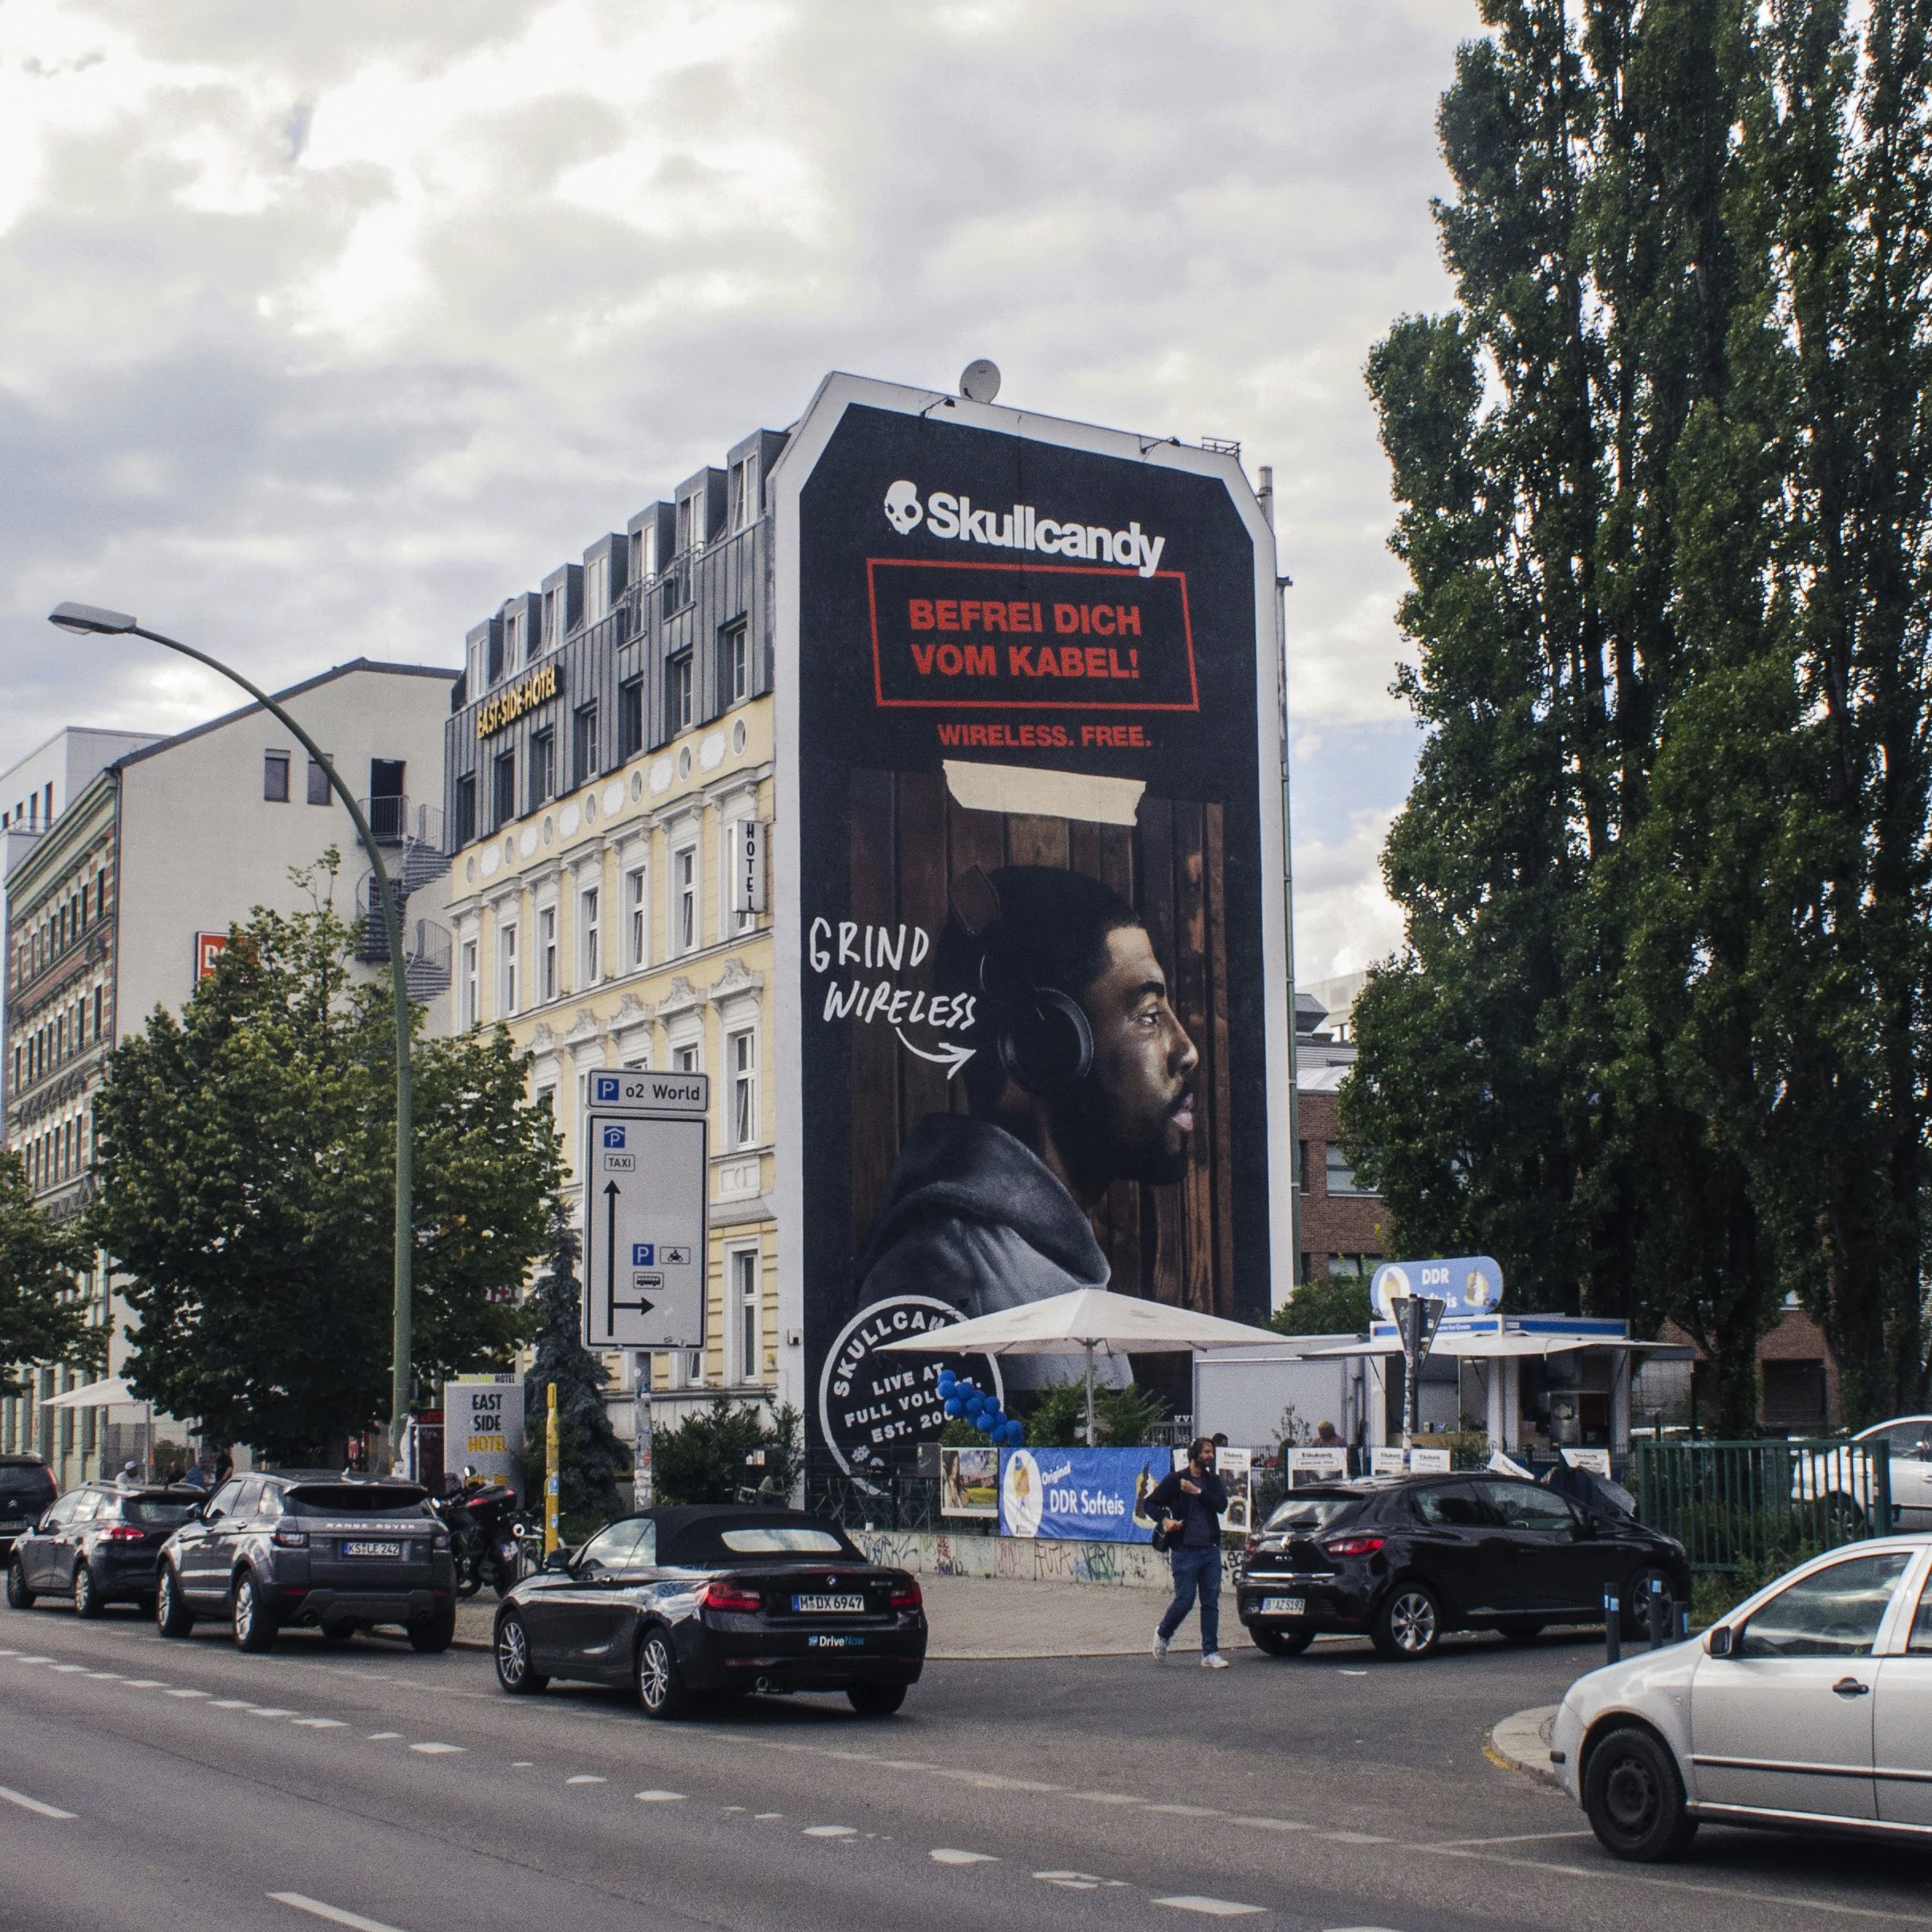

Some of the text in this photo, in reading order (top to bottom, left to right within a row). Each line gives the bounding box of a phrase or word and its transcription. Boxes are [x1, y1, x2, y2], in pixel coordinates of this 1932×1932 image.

[926, 492, 1166, 578] Skullcandy
[908, 598, 1141, 635] BEFREI DICH
[910, 644, 1139, 679] VOM KABEL!
[937, 723, 1152, 747] WIRELESS. FREE.
[746, 823, 755, 911] HOTEL
[809, 917, 929, 972] GRIND
[823, 980, 976, 1030] WIRELESS
[625, 1084, 644, 1098] o2
[652, 1085, 700, 1100] World
[608, 1157, 631, 1168] TAXI
[1421, 1268, 1450, 1286] DDR
[833, 1311, 947, 1397] SKULLCAN
[872, 1362, 944, 1396] LIVE AT
[472, 1394, 502, 1410] EAST
[473, 1415, 501, 1431] SIDE
[844, 1403, 892, 1428] FULL
[466, 1435, 506, 1452] HOTEL
[871, 1420, 913, 1443] EST.
[1050, 1490, 1125, 1515] DDR Softeis
[833, 1596, 863, 1609] 6947
[819, 1635, 866, 1647] DriveNow
